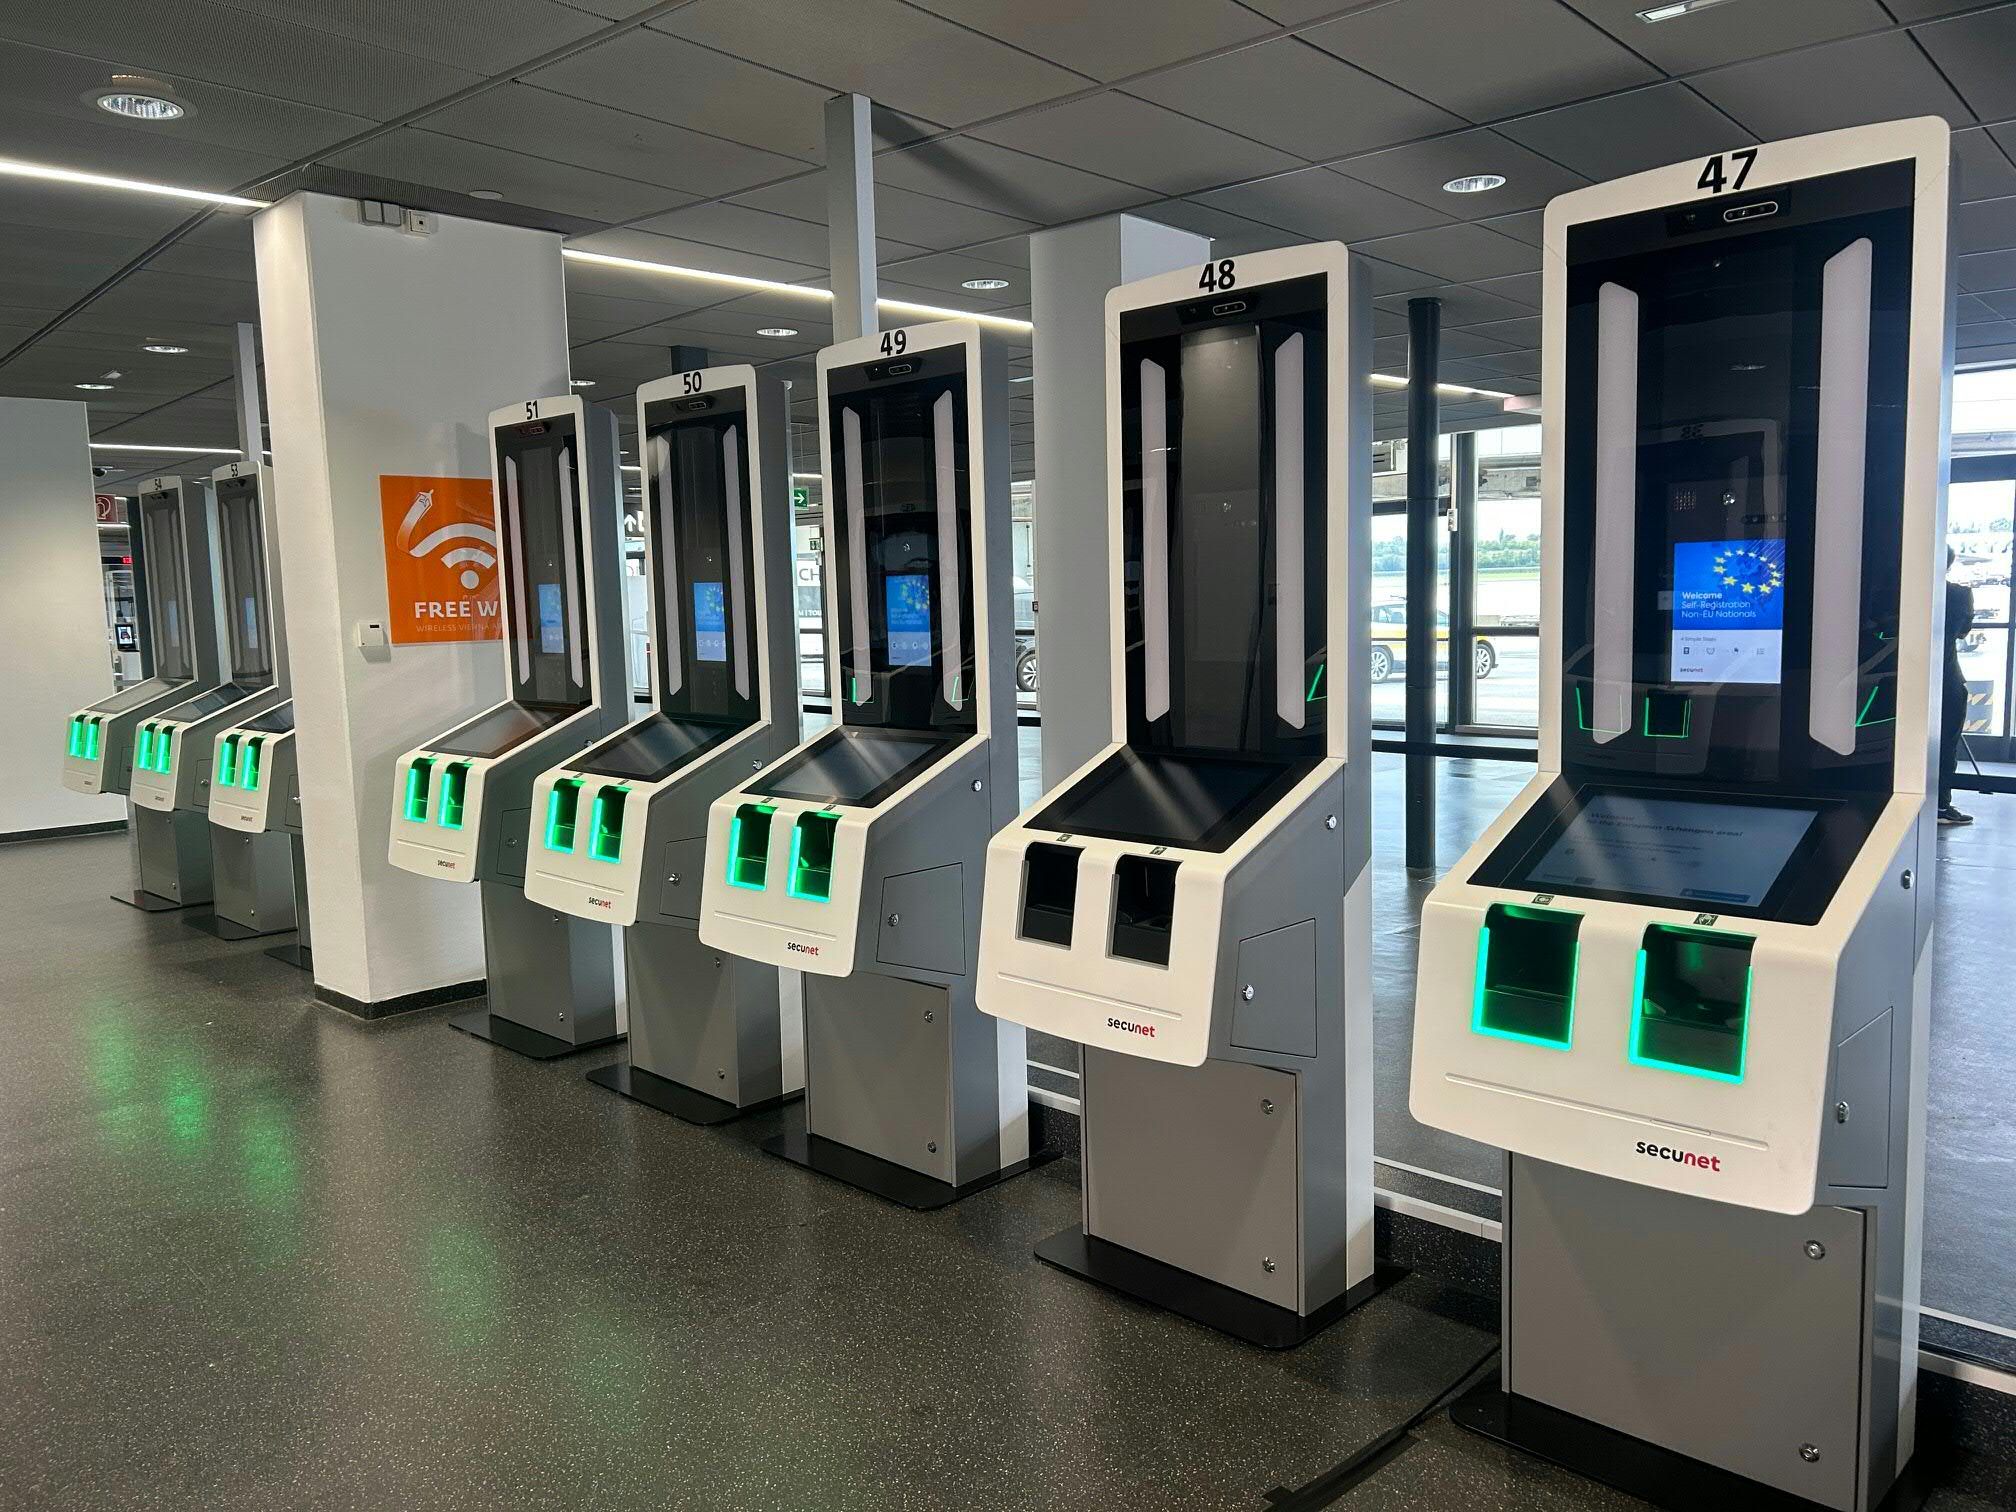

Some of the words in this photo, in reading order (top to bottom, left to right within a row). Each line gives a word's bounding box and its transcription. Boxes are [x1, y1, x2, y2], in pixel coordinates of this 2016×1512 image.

[1696, 147, 1758, 194] 47
[1198, 259, 1236, 293] 48
[880, 329, 907, 356] 49
[683, 371, 702, 395] 50
[525, 399, 539, 420] 51
[230, 463, 239, 477] 53
[154, 478, 162, 491] 54
[1681, 591, 1723, 600] Welcome
[1681, 600, 1751, 610] Self-Registration
[414, 601, 471, 619] FREE
[477, 600, 498, 617] W
[1681, 610, 1714, 618] Non-EU
[1716, 610, 1757, 618] Nationals
[415, 623, 457, 633] WIRELESS
[787, 941, 819, 956] secunet
[1107, 1017, 1156, 1038] secunet
[1635, 1141, 1721, 1172] secunet
